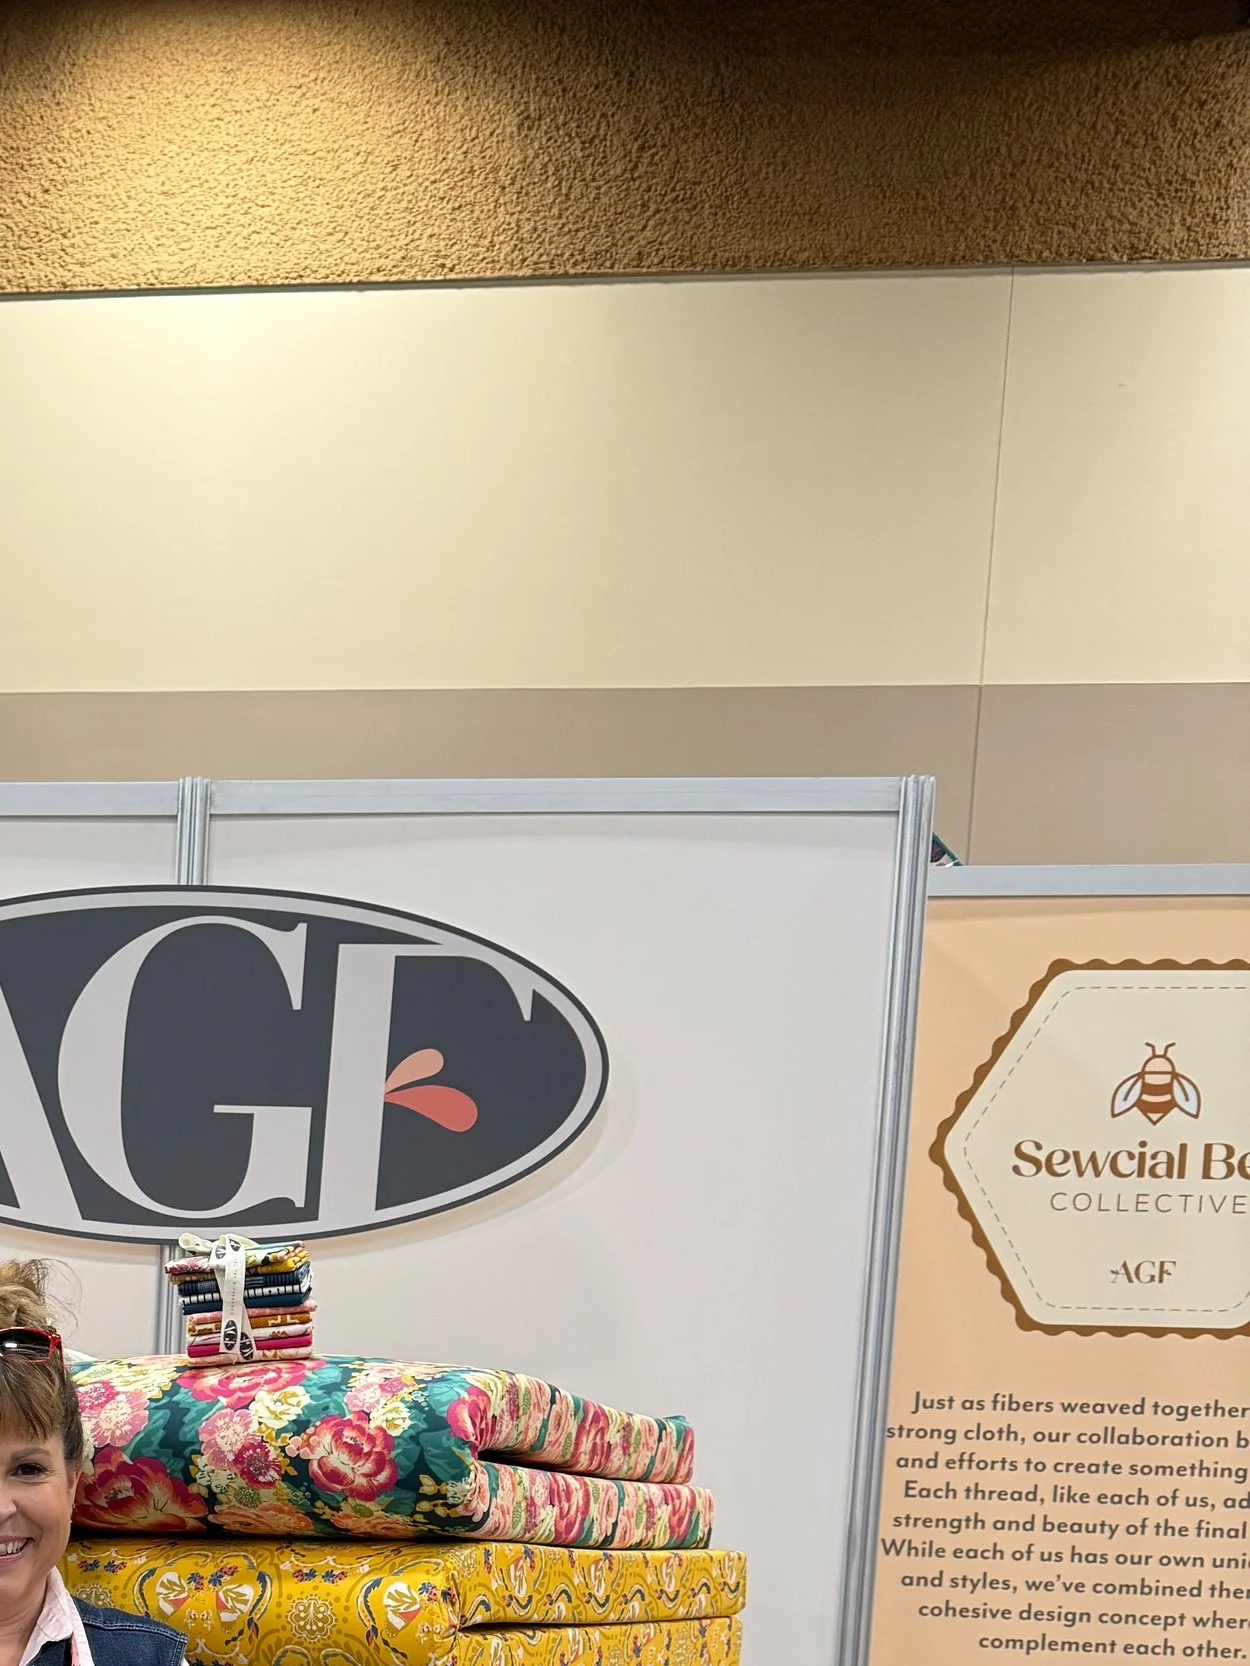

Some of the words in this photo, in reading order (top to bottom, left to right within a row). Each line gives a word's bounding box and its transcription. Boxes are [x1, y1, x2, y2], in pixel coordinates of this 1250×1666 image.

[1012, 1140, 1188, 1180] Sewcial
[1050, 1192, 1247, 1214] COLLECTIVE
[1111, 1260, 1176, 1284] AGF
[911, 1391, 955, 1414] Just
[961, 1399, 985, 1412] as
[991, 1393, 1054, 1413] fibers
[1060, 1397, 1145, 1416] weaved
[1152, 1399, 1250, 1422] together
[886, 1424, 957, 1445] strong
[963, 1422, 1025, 1446] cloth,
[1033, 1431, 1071, 1443] our
[1076, 1426, 1229, 1448] collaboration
[896, 1451, 939, 1470] and
[945, 1451, 1018, 1472] efforts
[1024, 1458, 1046, 1472] to
[1053, 1460, 1122, 1475] create
[1128, 1459, 1248, 1484] something
[904, 1480, 957, 1500] Each
[964, 1482, 1044, 1505] thread,
[1053, 1484, 1090, 1504] like
[1097, 1487, 1149, 1506] each
[1156, 1488, 1180, 1507] of
[1185, 1495, 1216, 1511] us,
[893, 1512, 986, 1534] strength
[992, 1514, 1035, 1532] and
[1042, 1514, 1120, 1540] beauty
[1125, 1517, 1149, 1535] of
[1154, 1518, 1189, 1537] the
[1195, 1519, 1247, 1540] final
[881, 1538, 946, 1559] While
[952, 1542, 1004, 1560] each
[1011, 1543, 1034, 1562] of
[1040, 1551, 1063, 1563] us
[1070, 1545, 1108, 1564] has
[1115, 1553, 1153, 1566] our
[1159, 1555, 1204, 1568] own
[1212, 1552, 1250, 1570] uni
[901, 1570, 944, 1588] and
[950, 1571, 1017, 1594] styles,
[1092, 1577, 1202, 1598] combined
[919, 1600, 1012, 1621] cohesive
[1019, 1603, 1091, 1629] design
[1098, 1613, 1186, 1632] concept
[979, 1633, 1117, 1656] complement
[1123, 1638, 1175, 1657] each
[1182, 1640, 1247, 1660] other.
